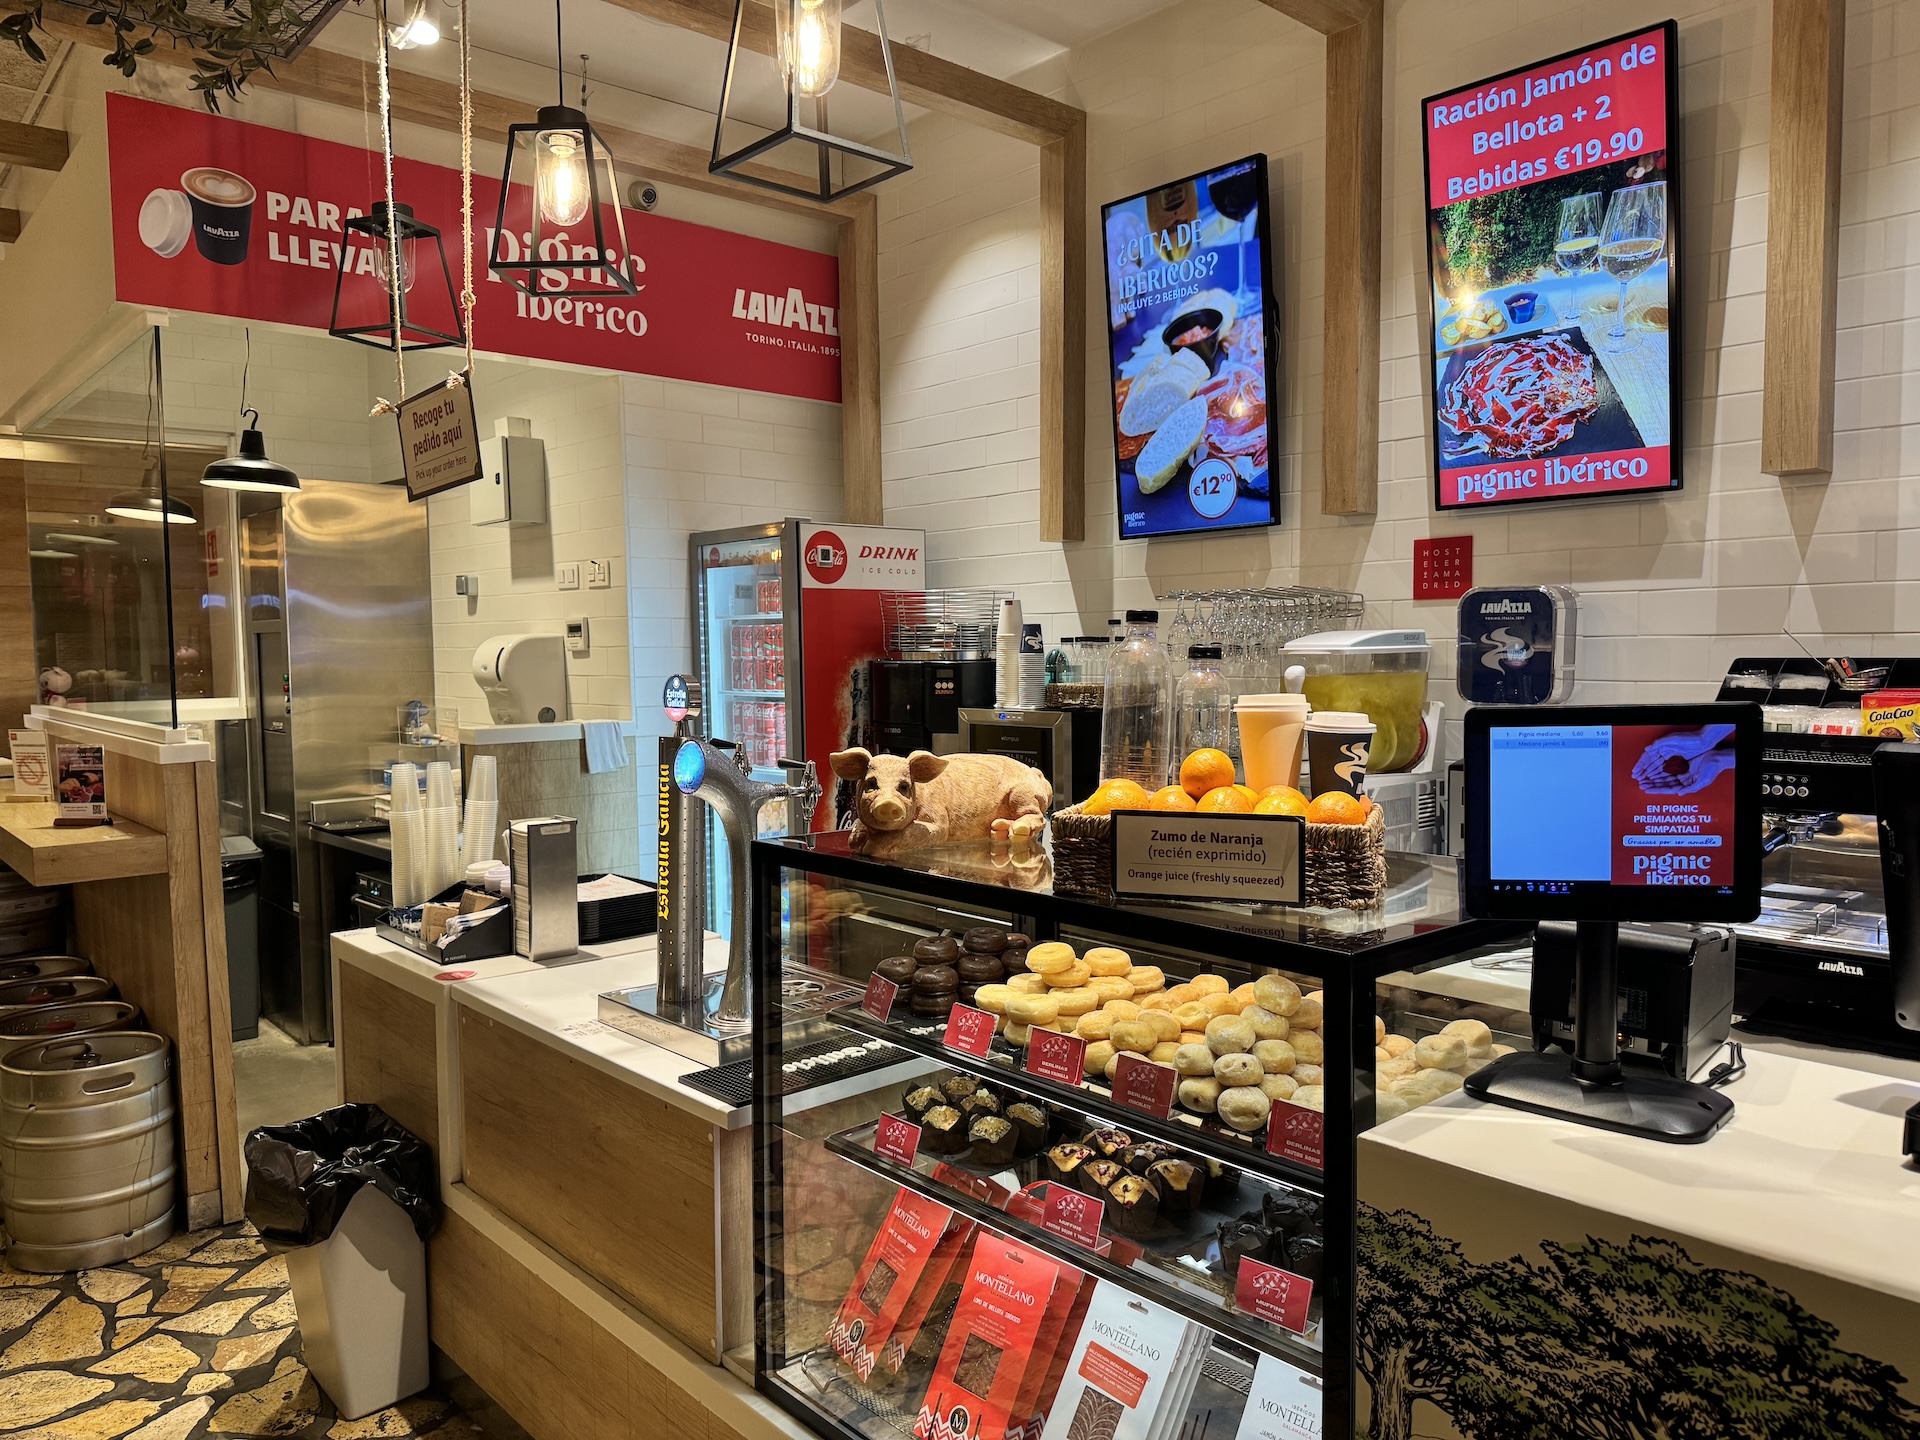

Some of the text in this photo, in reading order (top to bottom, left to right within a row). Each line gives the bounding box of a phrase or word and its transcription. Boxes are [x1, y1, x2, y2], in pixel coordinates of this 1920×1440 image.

[1433, 43, 1657, 129] Ración Jamón de
[1473, 95, 1612, 155] Bellota + 2
[1447, 127, 1644, 200] Bebidas €19.90
[266, 190, 370, 238] PARA
[1116, 218, 1204, 267] ¿CITA DE
[268, 231, 390, 281] LLEVA
[1118, 251, 1219, 300] IBÉRICOS?
[1118, 284, 1200, 313] INCLUYE 2 BEBIDAS
[731, 287, 840, 337] LAVAZZ
[412, 399, 455, 430] Recoge tu
[413, 418, 462, 462] pedido aquí
[415, 455, 467, 480] Pick up your order here
[1457, 456, 1649, 502] pignic ibérico
[858, 545, 919, 561] DRINK
[1480, 598, 1532, 614] LAVAZZA
[1869, 707, 1915, 723] ColaCao
[1633, 814, 1712, 823] PREMIAMOS TU
[1646, 804, 1699, 813] EN PIGNIC
[1150, 829, 1263, 848] Zumo de Naranja
[1627, 837, 1657, 845] Gracias
[1148, 844, 1267, 866] (recién exprimido)
[1633, 852, 1712, 875] pignic
[1127, 868, 1285, 889] Orange juice (freshly squeezed)
[1646, 871, 1711, 886] ibérico
[1818, 960, 1865, 977] LAVAZZA
[1286, 1140, 1321, 1155] BERLINAS
[893, 1205, 931, 1239] MONTELLANO
[974, 1270, 1035, 1306] MONTELLANO
[1255, 1298, 1286, 1314] MUFFINS
[1091, 1319, 1161, 1361] MONTELLANO
[1291, 1404, 1316, 1418] IBÉRICOS
[1282, 1423, 1312, 1440] SALAMANCA
